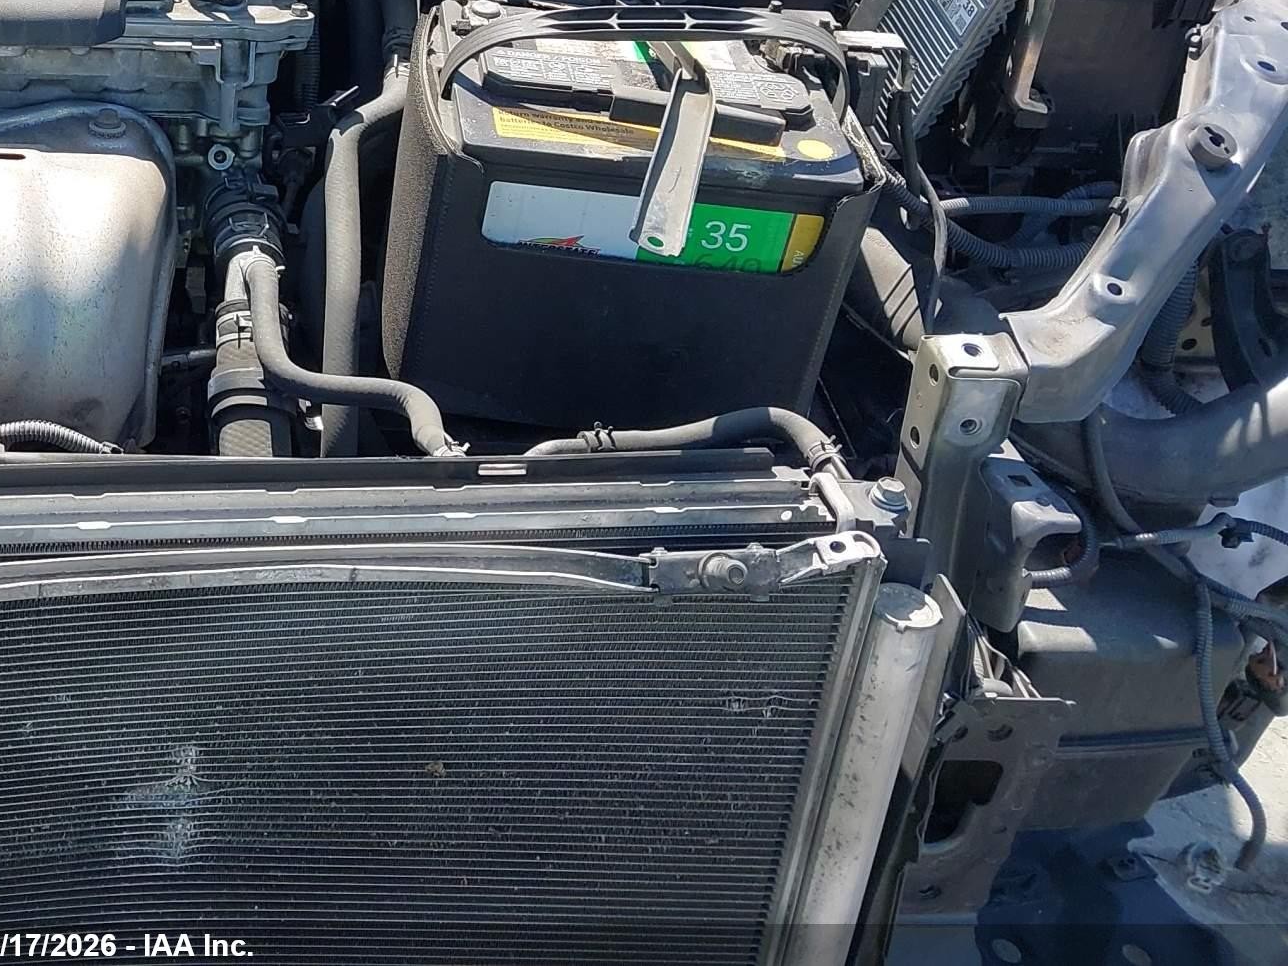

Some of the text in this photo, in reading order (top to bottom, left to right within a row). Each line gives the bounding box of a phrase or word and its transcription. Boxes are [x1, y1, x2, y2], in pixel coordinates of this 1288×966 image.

[553, 122, 585, 130] Costco
[586, 124, 634, 134] Wholesale
[700, 221, 751, 252] 35
